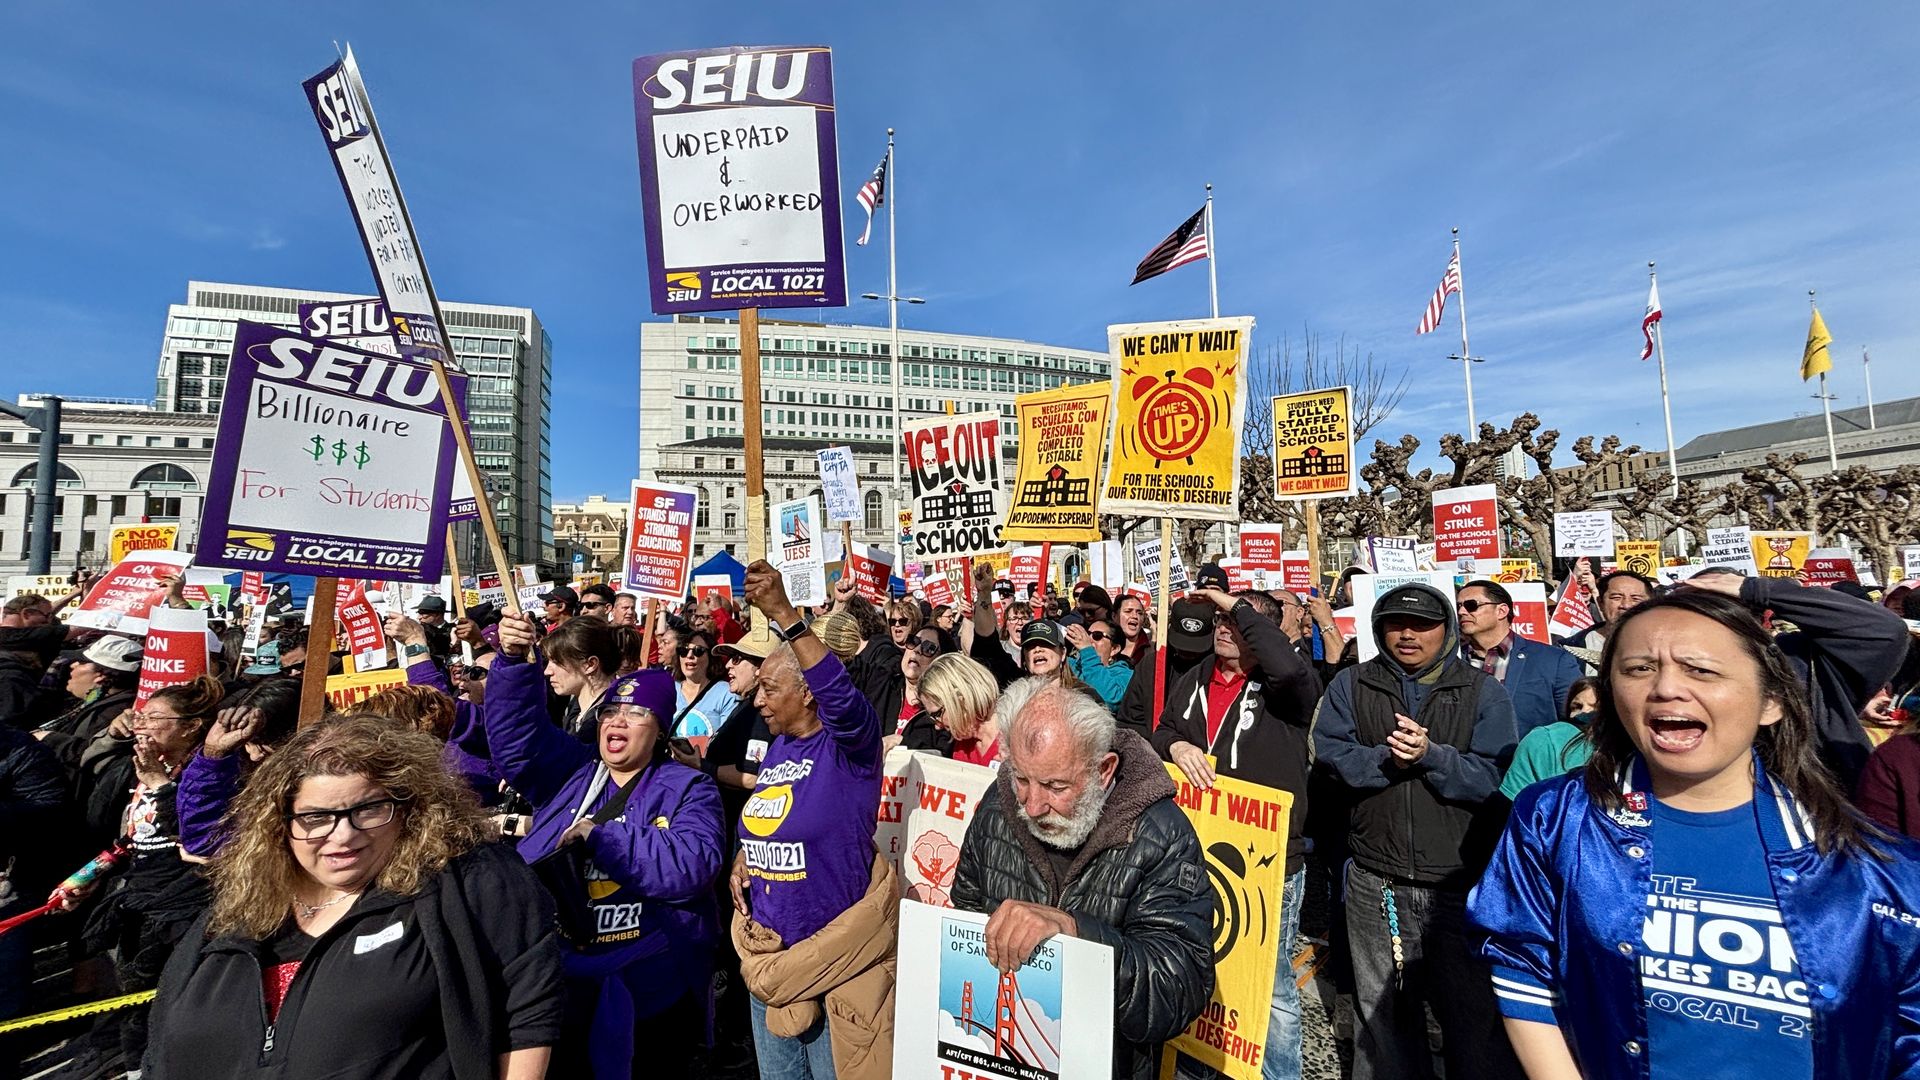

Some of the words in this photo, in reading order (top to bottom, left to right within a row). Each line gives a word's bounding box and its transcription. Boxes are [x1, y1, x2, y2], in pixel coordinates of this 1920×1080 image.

[653, 52, 808, 110] SEIU
[663, 125, 789, 159] UNDERPAID
[673, 192, 822, 227] OVERWORKED
[371, 211, 400, 242] UNITED
[732, 268, 764, 276] Employees
[667, 289, 702, 302] SEIU
[711, 276, 776, 292] LOCAL
[782, 274, 825, 290] 1021
[310, 303, 389, 337] SEIU
[399, 335, 412, 346] SEIU
[1122, 337, 1146, 357] WE
[1151, 333, 1202, 354] CAN'T
[1203, 329, 1239, 352] WAIT
[257, 338, 440, 406] SEIU
[257, 384, 410, 437] Billionaire
[1041, 401, 1088, 416] NECESITAMOS
[1153, 401, 1188, 416] TIME'S
[1287, 399, 1316, 410] STUDENTS
[1318, 397, 1335, 407] NEED
[1031, 414, 1075, 429] ESCUELAS
[1077, 409, 1098, 424] CON
[1288, 406, 1333, 419] FULLY
[1153, 413, 1196, 447] UP
[1278, 415, 1344, 430] STAFFED,
[1041, 424, 1085, 440] PERSONAL
[1282, 424, 1337, 438] STABLE
[1037, 437, 1083, 453] COMPLETO
[1278, 432, 1346, 447] SCHOOLS
[904, 426, 953, 499] ICE
[953, 419, 999, 490] OUT
[1038, 453, 1044, 465] Y
[1045, 450, 1083, 464] ESTABLE
[1123, 473, 1142, 487] FOR
[1144, 474, 1162, 487] THE
[1164, 474, 1214, 489] SCHOOLS
[1280, 482, 1294, 492] WE
[1295, 478, 1320, 490] CAN'T
[1322, 476, 1346, 489] WAIT!
[240, 468, 298, 498] For
[319, 477, 431, 512] Students
[1108, 486, 1127, 500] OUR
[1129, 487, 1179, 503] STUDENTS
[1181, 489, 1232, 505] DESERVE
[458, 502, 476, 513] 1021
[654, 497, 675, 509] SF
[1452, 504, 1471, 515] ON
[637, 507, 666, 523] STANDS
[668, 511, 689, 526] WITH
[936, 521, 953, 529] OF
[962, 517, 990, 527] OUR
[1012, 512, 1021, 524] NO
[1022, 512, 1057, 525] PODEMOS
[1058, 512, 1092, 525] ESPERAR
[1444, 517, 1484, 530] STRIKE
[128, 529, 160, 540] NO
[644, 521, 679, 538] STRIKING
[1461, 530, 1497, 538] SCHOOLS
[122, 538, 168, 551] PODEMOS
[290, 536, 317, 544] Service
[319, 538, 357, 547] Employees
[359, 542, 403, 552] International
[637, 535, 682, 552] EDUCATORS
[916, 524, 1008, 556] SCHOOLS
[1373, 537, 1410, 549] SEIU
[1456, 538, 1491, 546] STUDENTS
[222, 547, 274, 561] SEIU
[287, 544, 367, 563] LOCAL
[376, 552, 423, 567] 1021
[784, 545, 810, 562] UESF
[1138, 549, 1146, 557] SF
[1451, 547, 1480, 555] DESERVE
[1705, 548, 1730, 557] MAKE
[635, 554, 649, 563] OUR
[648, 556, 680, 569] STUDENTS
[860, 561, 875, 572] ON
[1141, 555, 1160, 567] WITH
[1706, 554, 1751, 564] BILLIONAIRES
[132, 565, 155, 574] ON
[639, 565, 651, 574] ARE
[652, 566, 675, 577] WORTH
[111, 576, 160, 589] STRIKE
[636, 574, 663, 586] FIGHTING
[664, 578, 676, 588] FOR
[855, 571, 880, 584] TRIKE
[17, 589, 72, 597] BALANC
[105, 589, 125, 597] FOR
[482, 592, 494, 600] FOR
[520, 587, 536, 599] KEEP
[862, 585, 875, 593] OUR
[342, 604, 368, 619] STRIKE
[148, 636, 168, 652] ON
[1227, 792, 1282, 832] WAIT
[768, 842, 805, 870] 1021
[774, 871, 807, 881] MEMBER
[1659, 895, 1698, 911] THE
[596, 929, 640, 943] MEMBER
[951, 941, 964, 952] OF
[1728, 969, 1809, 1002] BAC
[1644, 992, 1758, 1030] OCAL
[1195, 1018, 1261, 1067] DESERVE
[945, 1047, 972, 1062] AFT/CFT
[990, 1062, 1018, 1075] AFL-CIO,
